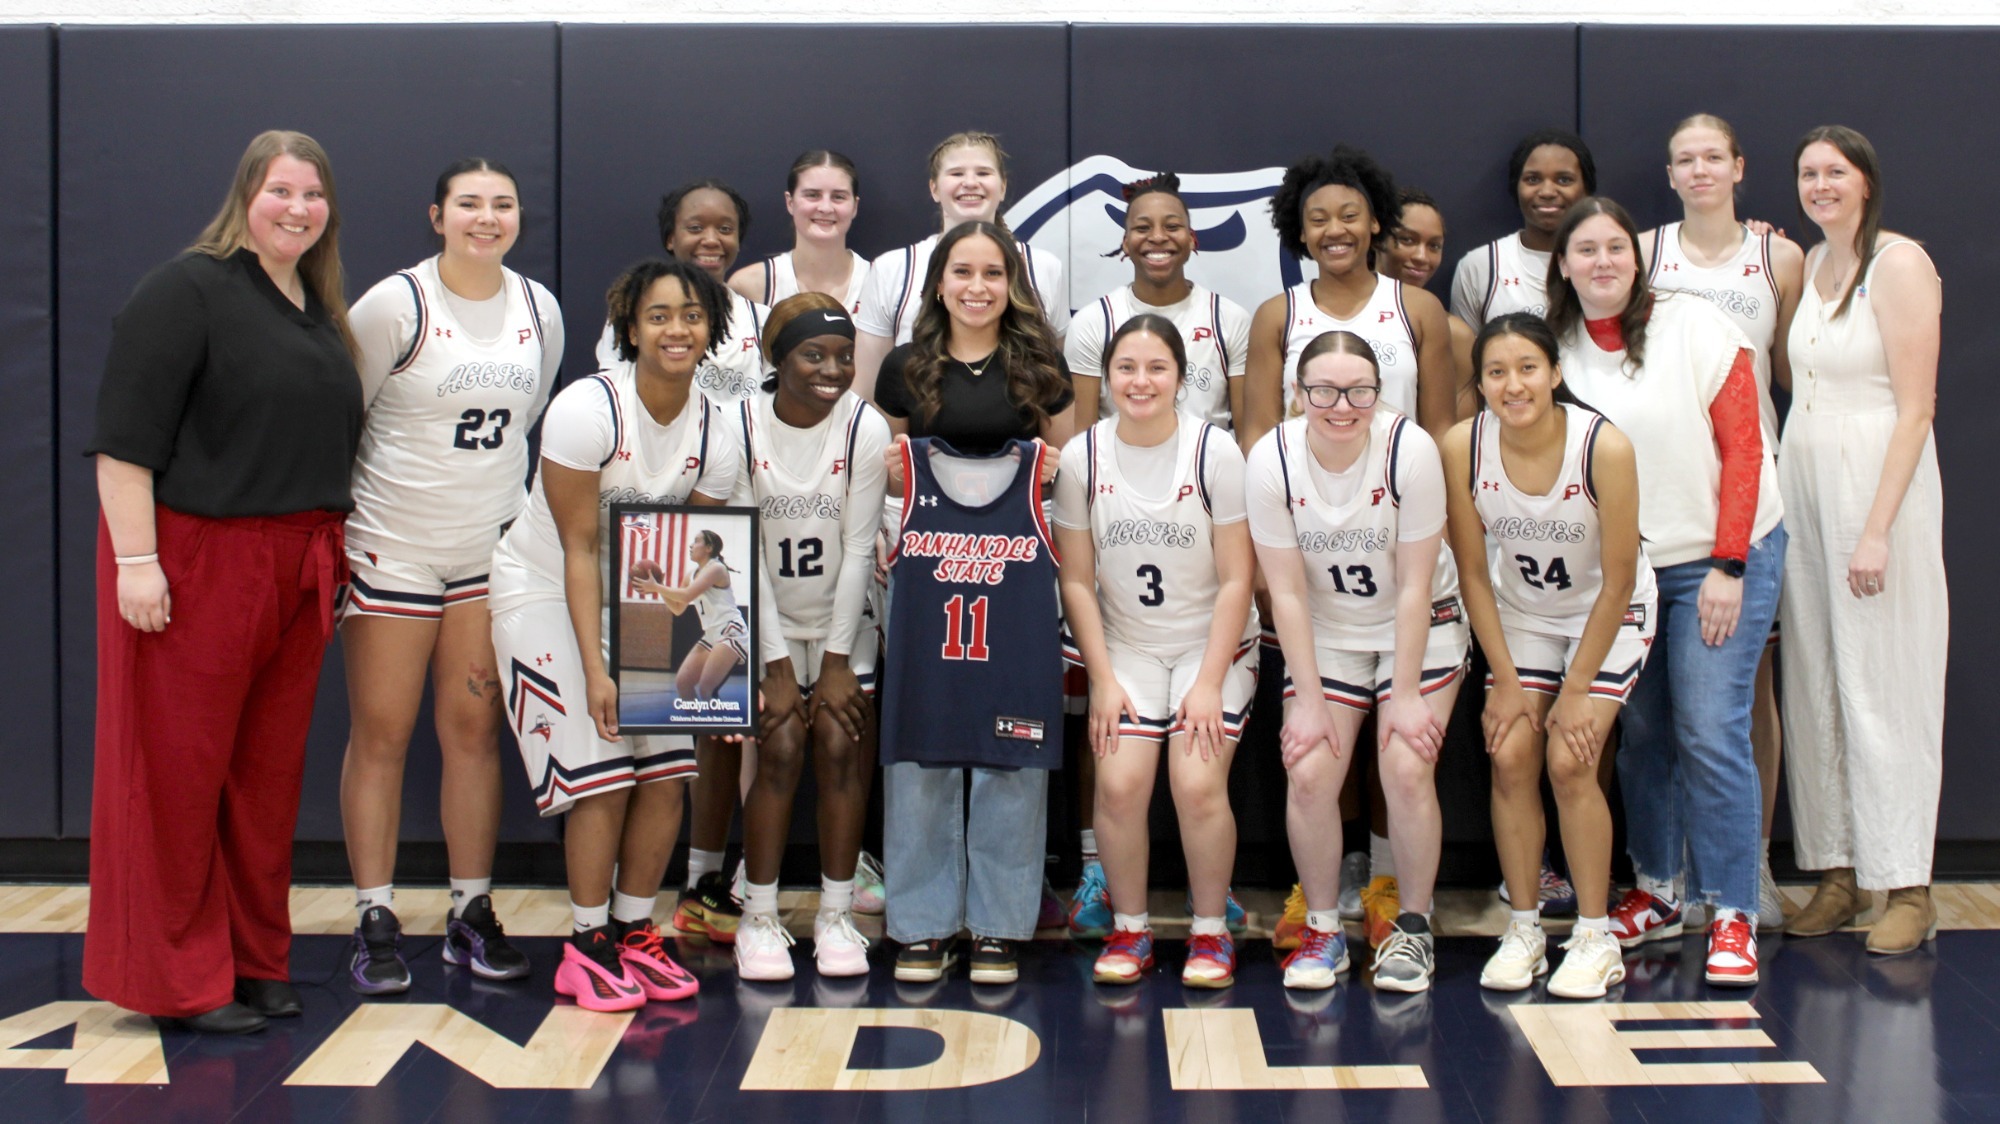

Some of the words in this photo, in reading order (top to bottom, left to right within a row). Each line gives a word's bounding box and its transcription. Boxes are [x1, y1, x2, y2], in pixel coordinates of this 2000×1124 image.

[1743, 264, 1760, 276] P
[1378, 311, 1395, 323] P
[517, 328, 532, 345] P
[1192, 327, 1212, 342] P
[437, 361, 535, 397] AGGIES
[453, 408, 511, 451] 23
[681, 457, 700, 475] P
[1177, 485, 1193, 502] P
[1371, 487, 1385, 507] P
[1563, 484, 1580, 500] P
[1100, 519, 1197, 550] AGGIES
[1492, 516, 1586, 544] AGGIES
[778, 537, 823, 577] 12
[902, 530, 1039, 563] PANHANDLE
[933, 558, 1005, 585] STATE
[1327, 564, 1378, 597] 13
[1515, 554, 1572, 591] 24
[1136, 564, 1165, 607] 3
[942, 594, 989, 662] 11
[673, 698, 709, 713] Carolyn
[709, 698, 741, 711] Olvera
